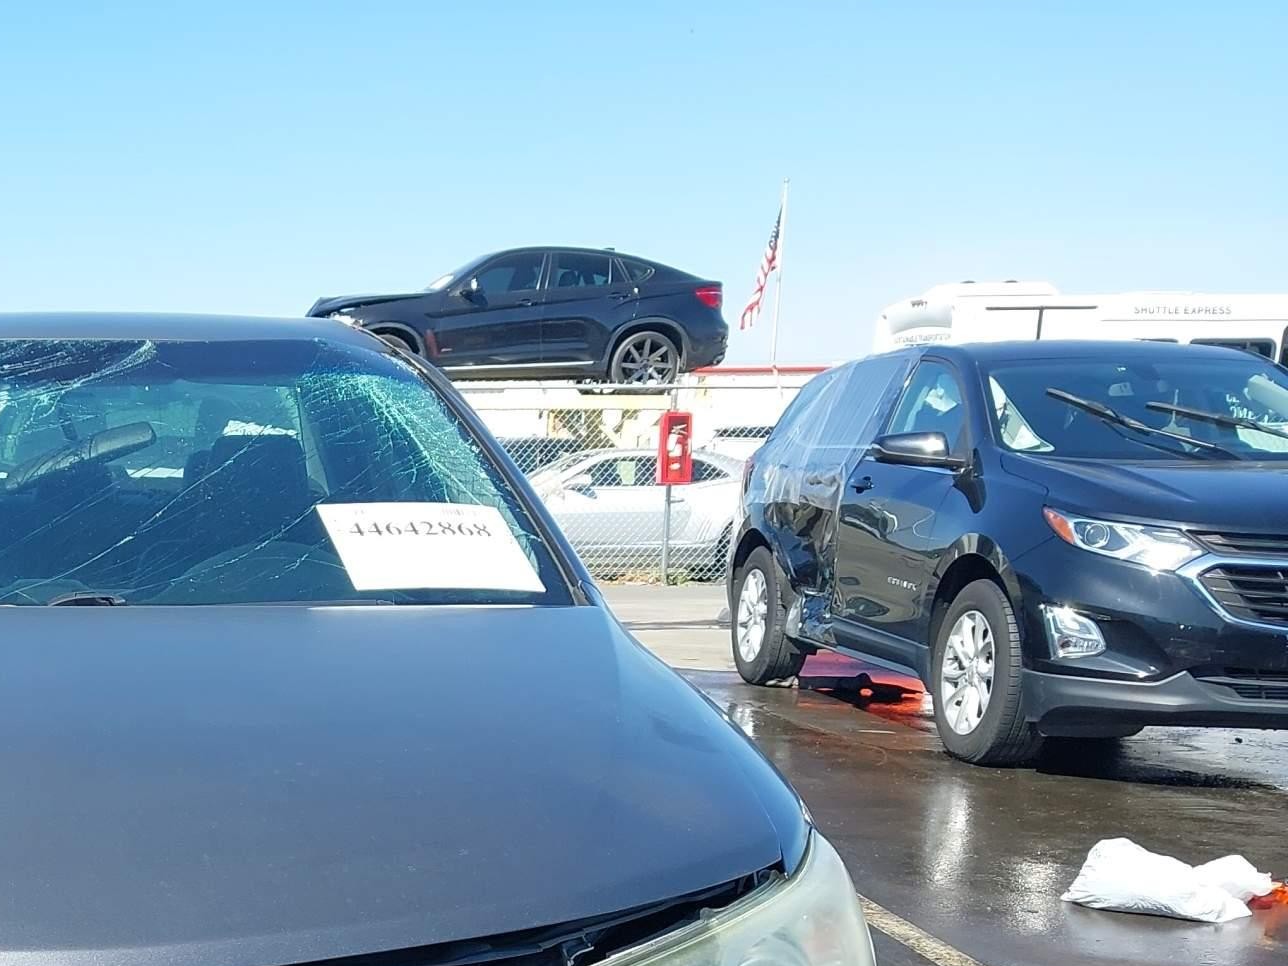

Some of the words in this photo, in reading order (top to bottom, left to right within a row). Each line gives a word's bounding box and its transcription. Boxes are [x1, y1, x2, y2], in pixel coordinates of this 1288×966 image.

[1133, 305, 1179, 315] SHUTTLE
[1183, 305, 1232, 315] EXPRESS
[349, 520, 492, 537] 44642868
